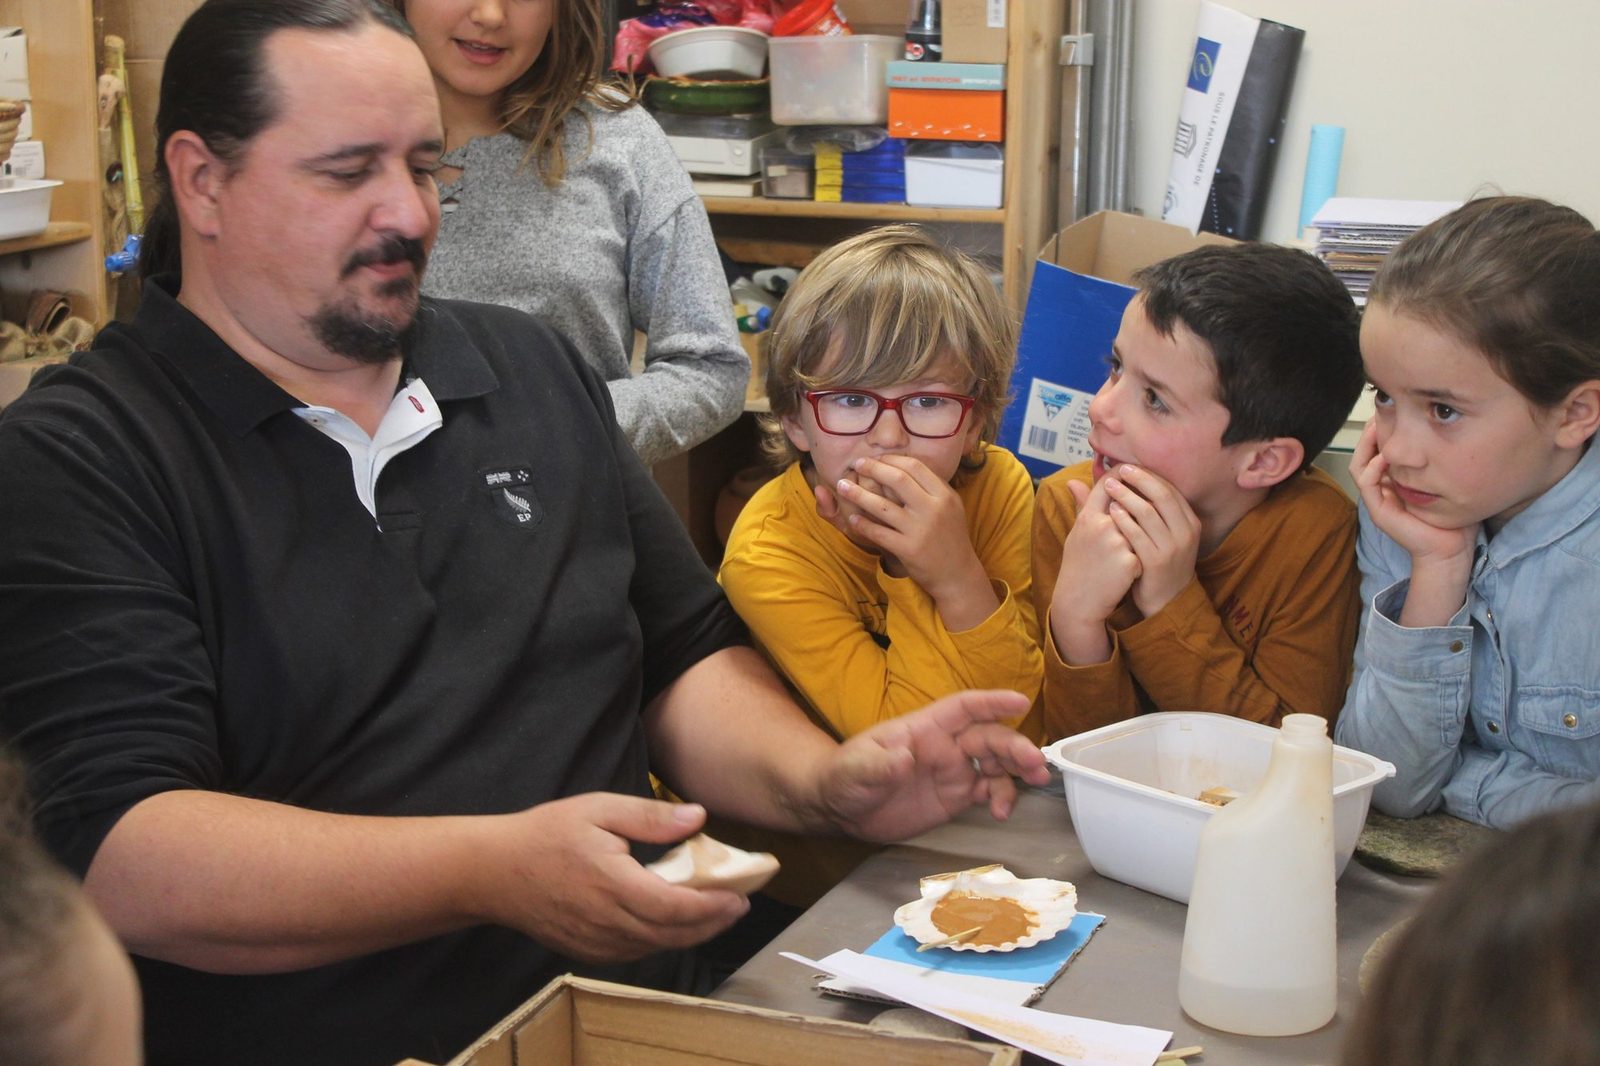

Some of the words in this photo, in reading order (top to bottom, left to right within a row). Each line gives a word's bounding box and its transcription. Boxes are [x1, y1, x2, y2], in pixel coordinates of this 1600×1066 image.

[1214, 92, 1225, 113] SOUS
[1211, 115, 1218, 124] LE
[1197, 127, 1215, 173] PATRONAGE
[517, 513, 531, 522] EP
